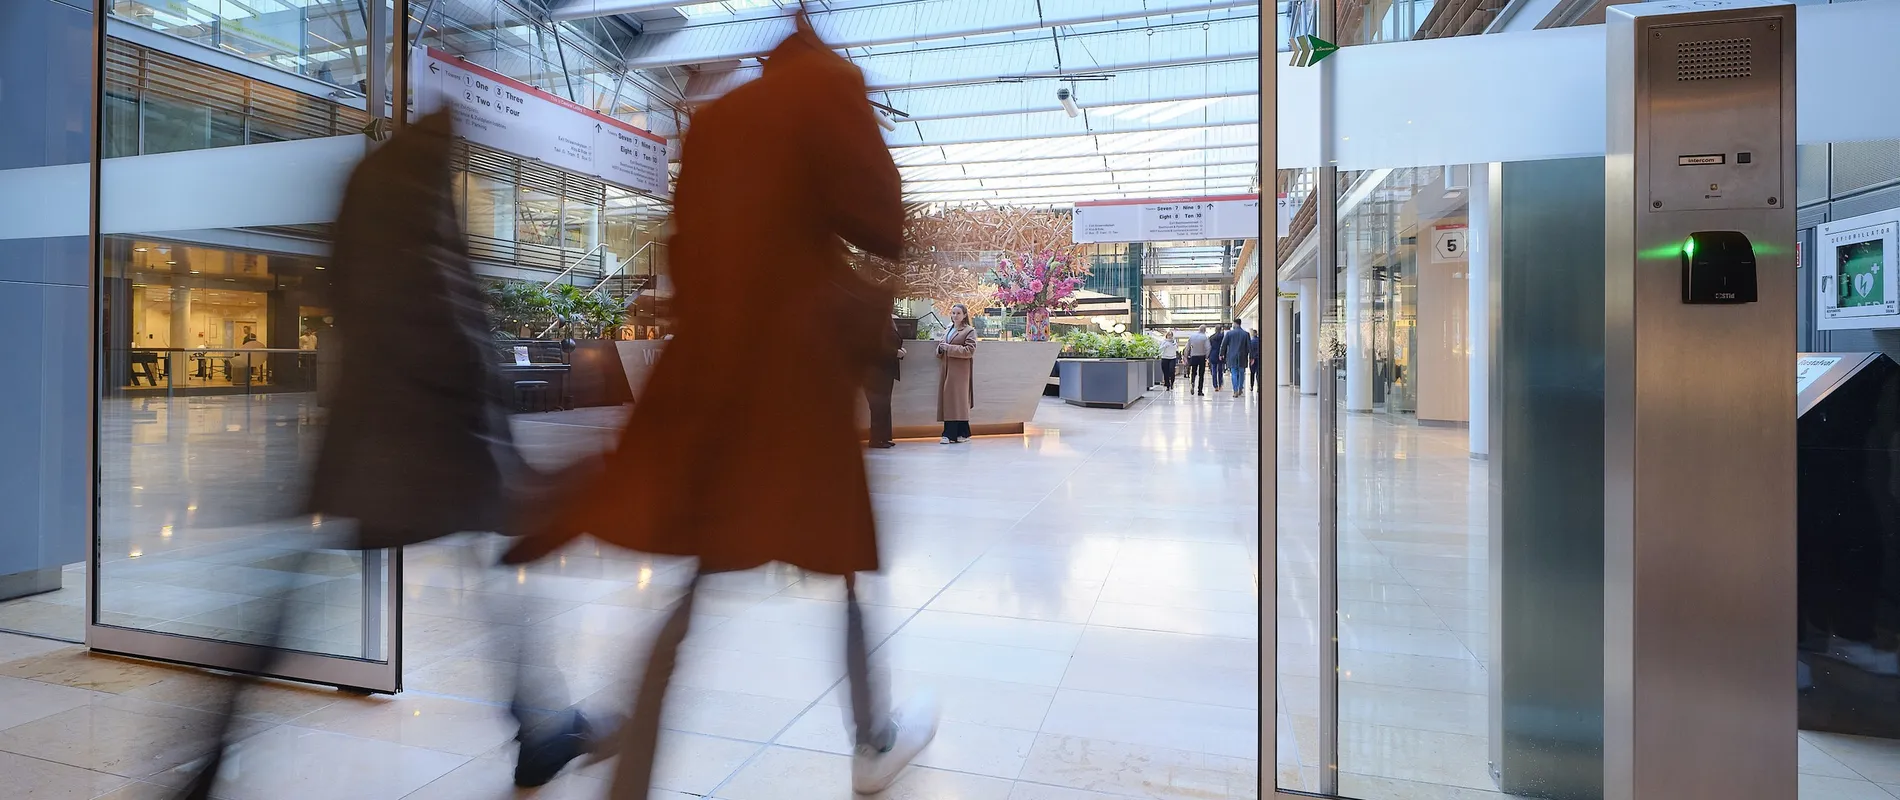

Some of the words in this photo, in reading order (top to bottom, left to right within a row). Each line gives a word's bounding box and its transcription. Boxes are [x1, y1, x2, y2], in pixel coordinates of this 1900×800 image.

[475, 81, 489, 91] One
[506, 92, 524, 104] Three
[466, 92, 471, 100] 2
[476, 96, 491, 107] Two
[505, 106, 520, 116] Four
[618, 133, 632, 143] Seven
[641, 141, 651, 150] Nine
[620, 146, 632, 155] Eight
[643, 153, 651, 161] Ten
[1831, 228, 1890, 243] DEFIBRILLATOR
[1447, 239, 1456, 252] 5
